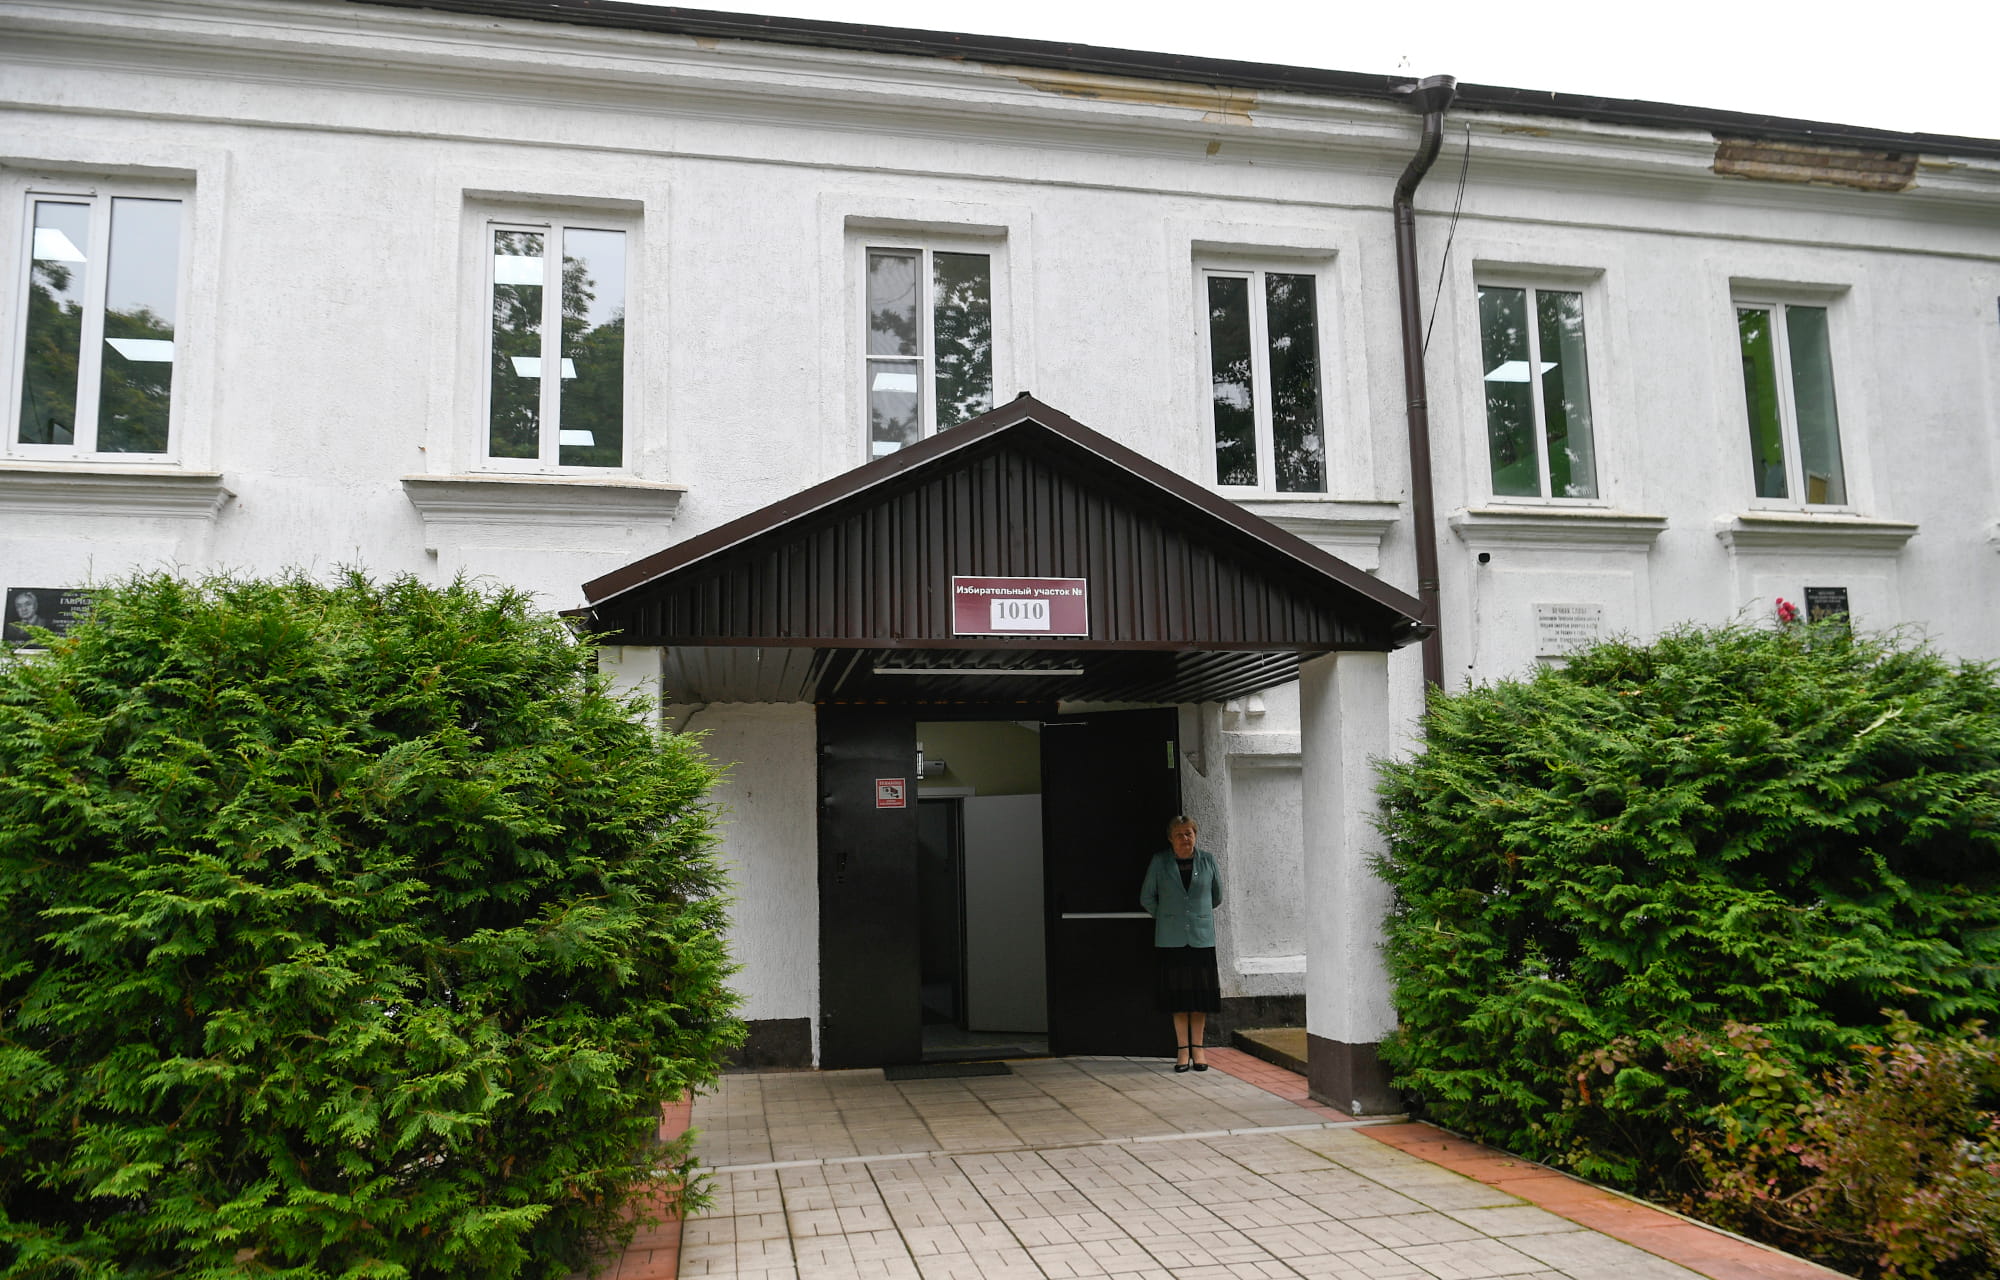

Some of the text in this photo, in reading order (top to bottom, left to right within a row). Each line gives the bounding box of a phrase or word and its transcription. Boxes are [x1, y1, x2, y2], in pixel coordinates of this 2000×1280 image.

[956, 586, 1083, 596] Избирательный участок №
[997, 602, 1044, 620] 1010
